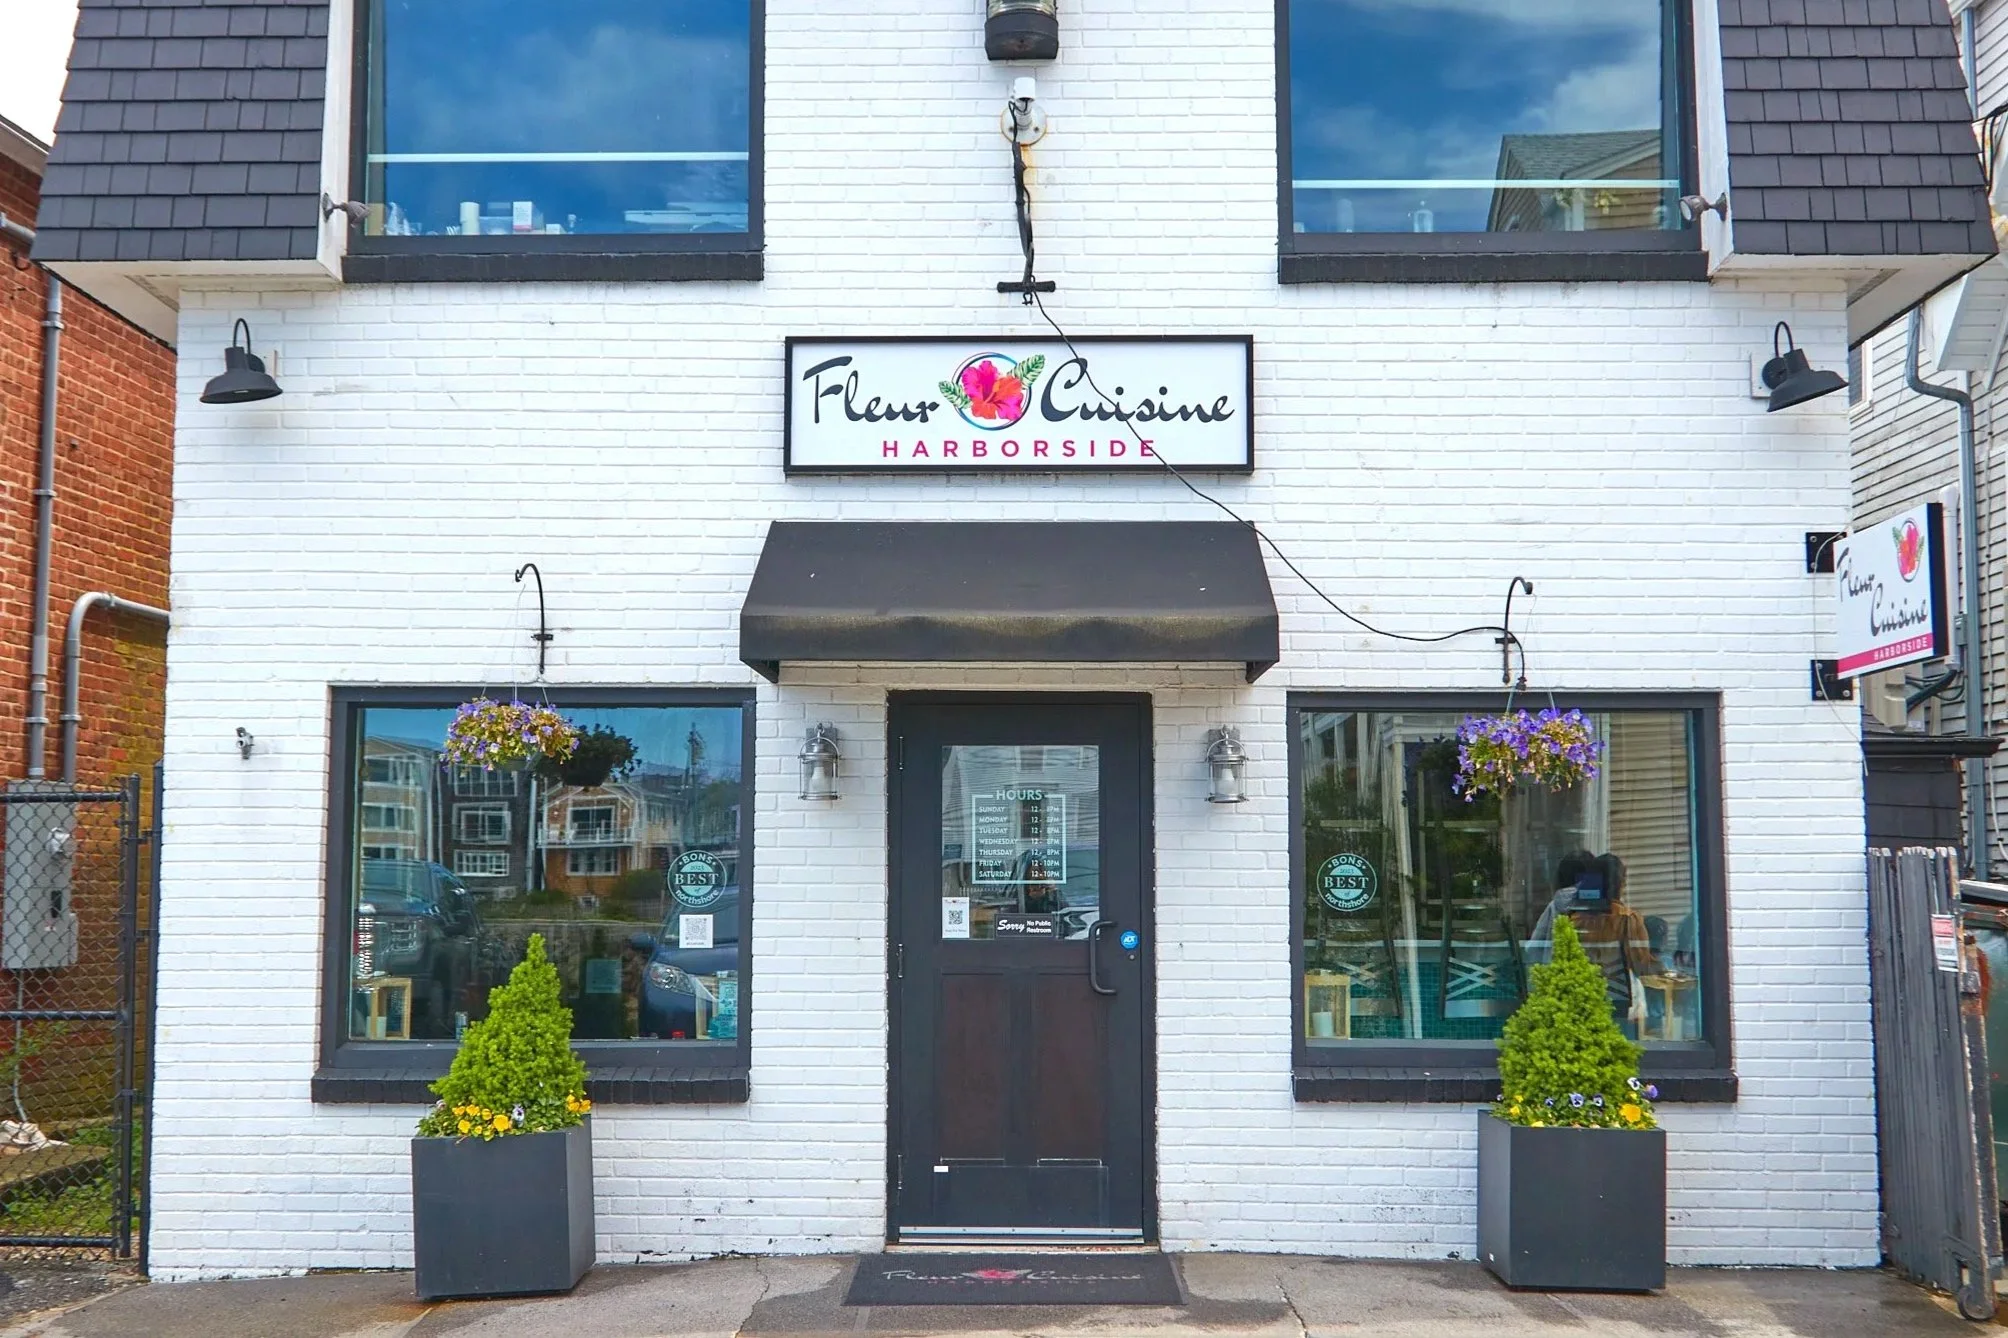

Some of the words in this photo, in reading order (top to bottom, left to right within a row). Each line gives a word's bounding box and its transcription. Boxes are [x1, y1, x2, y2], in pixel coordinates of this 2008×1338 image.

[803, 356, 940, 424] Fleur
[1040, 357, 1235, 423] Cuisine
[882, 440, 1156, 458] HARBORSIDE
[1836, 547, 1875, 603] Fleur
[1870, 582, 1928, 637] Cuisine
[1873, 636, 1928, 661] HARBORSIDE
[996, 789, 1042, 801] HOURS
[682, 853, 713, 864] BONS
[1331, 856, 1363, 867] BONS
[675, 873, 719, 885] BEST
[1324, 876, 1369, 888] BEST
[675, 890, 719, 905] northshore
[1325, 893, 1369, 908] northshore
[997, 919, 1026, 932] Sorry
